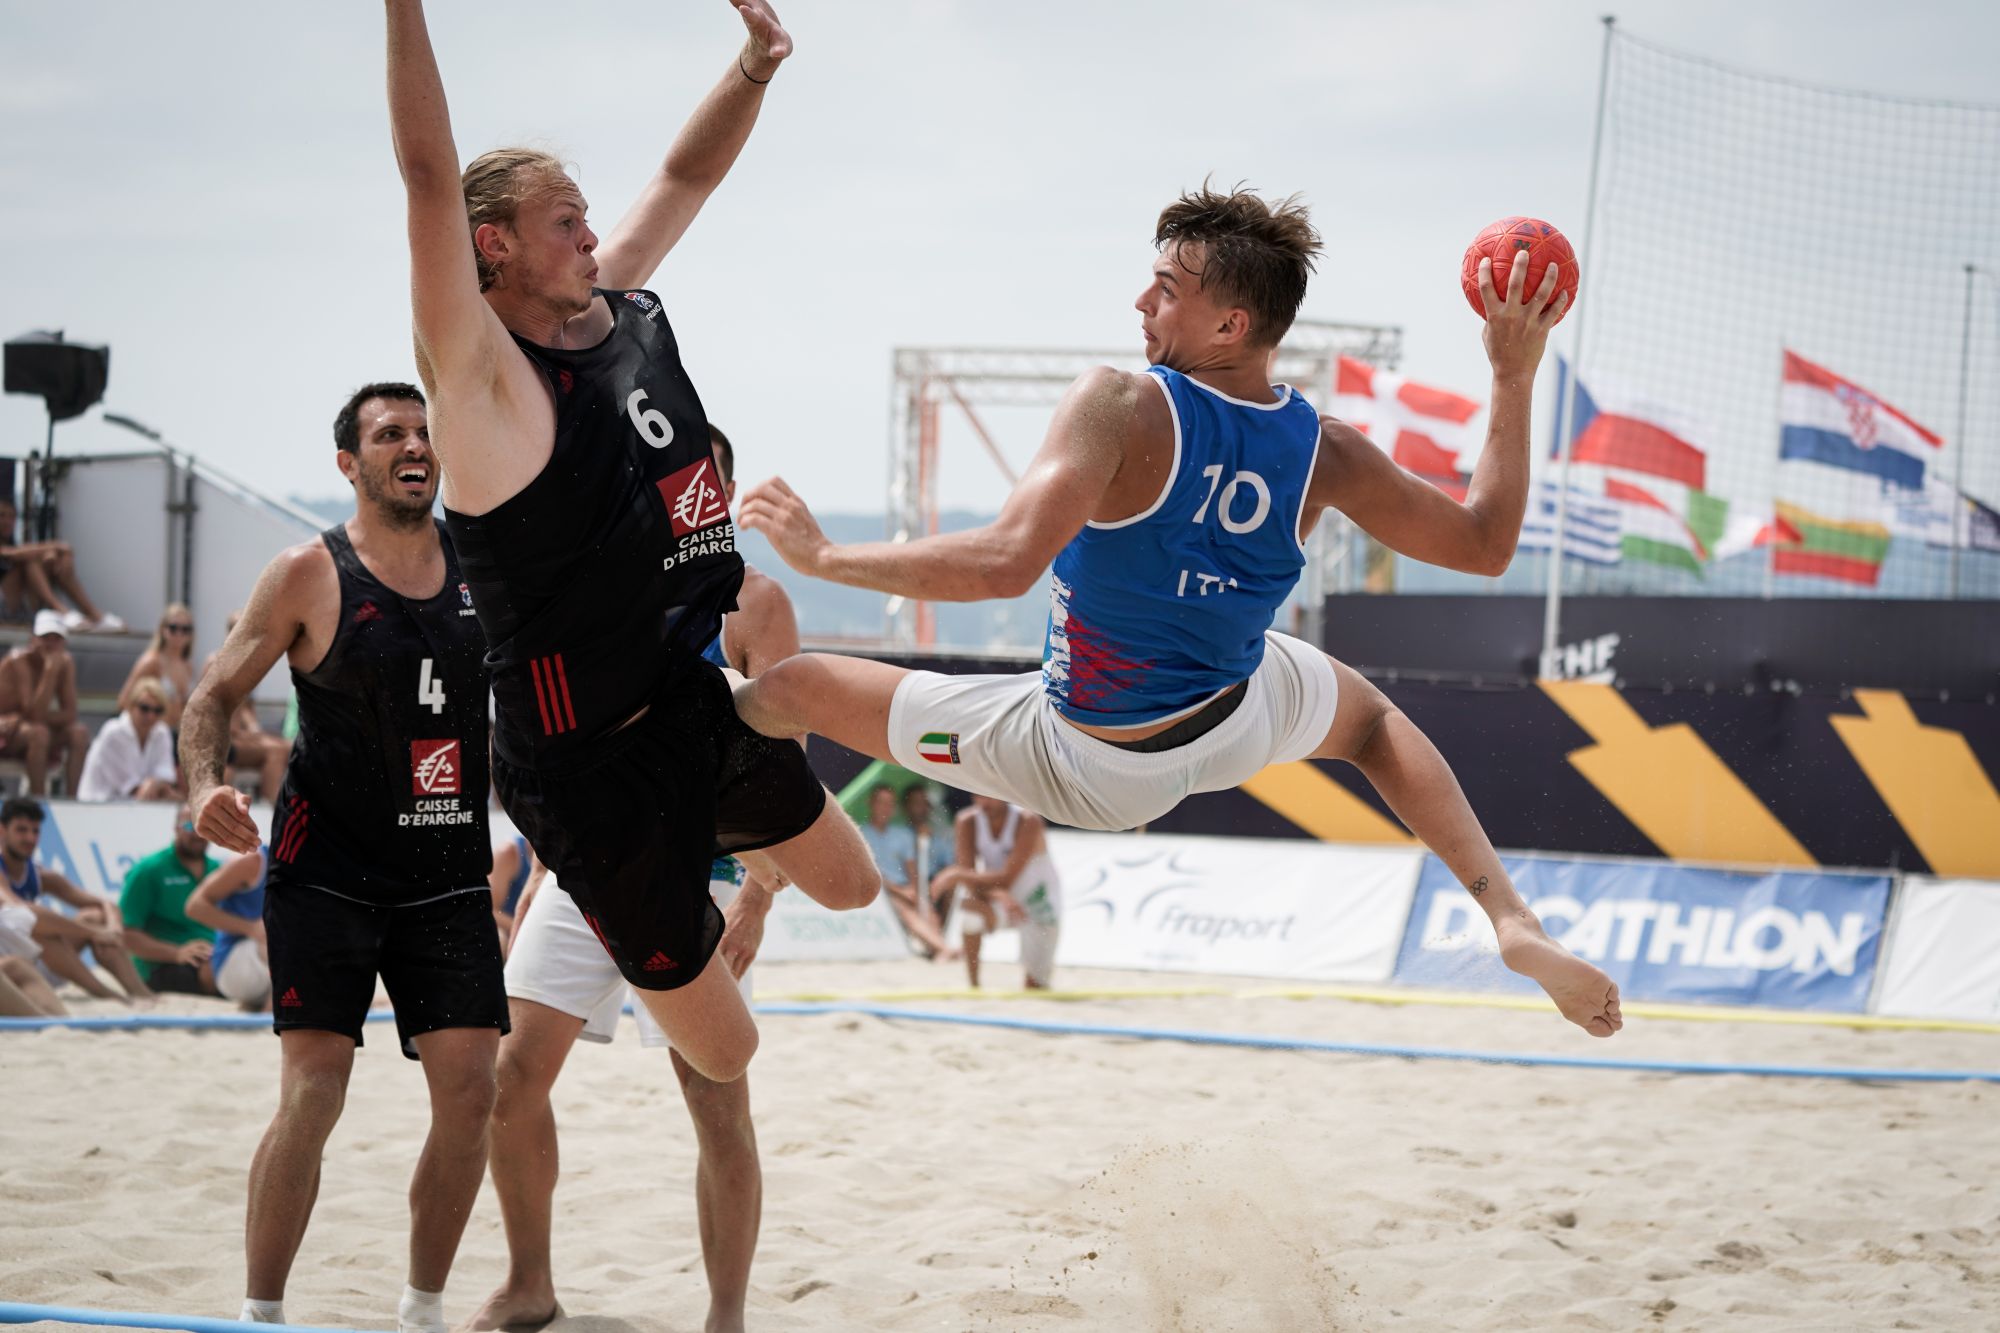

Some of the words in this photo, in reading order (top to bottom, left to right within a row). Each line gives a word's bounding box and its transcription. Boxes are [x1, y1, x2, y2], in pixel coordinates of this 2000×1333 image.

[627, 388, 674, 449] 6
[1192, 464, 1271, 534] 10
[679, 524, 735, 549] CAISSE
[663, 539, 733, 571] D'EPARG
[418, 658, 446, 714] 4
[398, 811, 474, 826] D'EPARGNE
[415, 799, 460, 813] CAISSE
